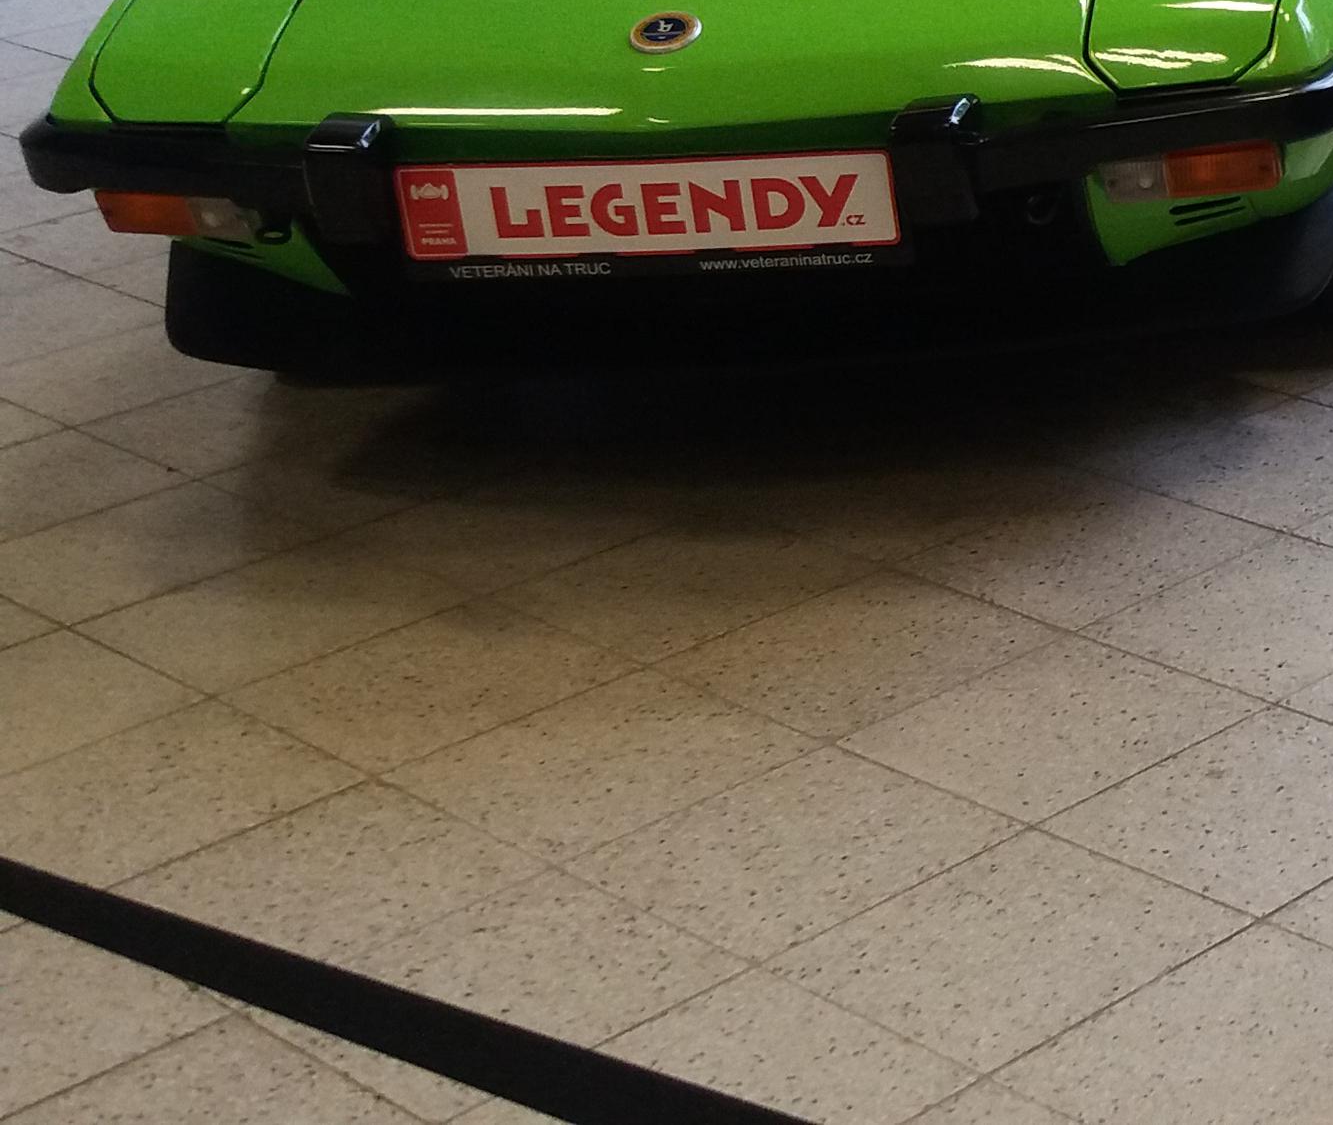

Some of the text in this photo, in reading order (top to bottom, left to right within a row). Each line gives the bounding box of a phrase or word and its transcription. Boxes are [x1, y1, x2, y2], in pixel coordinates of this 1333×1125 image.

[539, 262, 563, 277] NA
[565, 260, 612, 276] TRUC
[700, 252, 874, 271] www.veteraninatruc.cz
